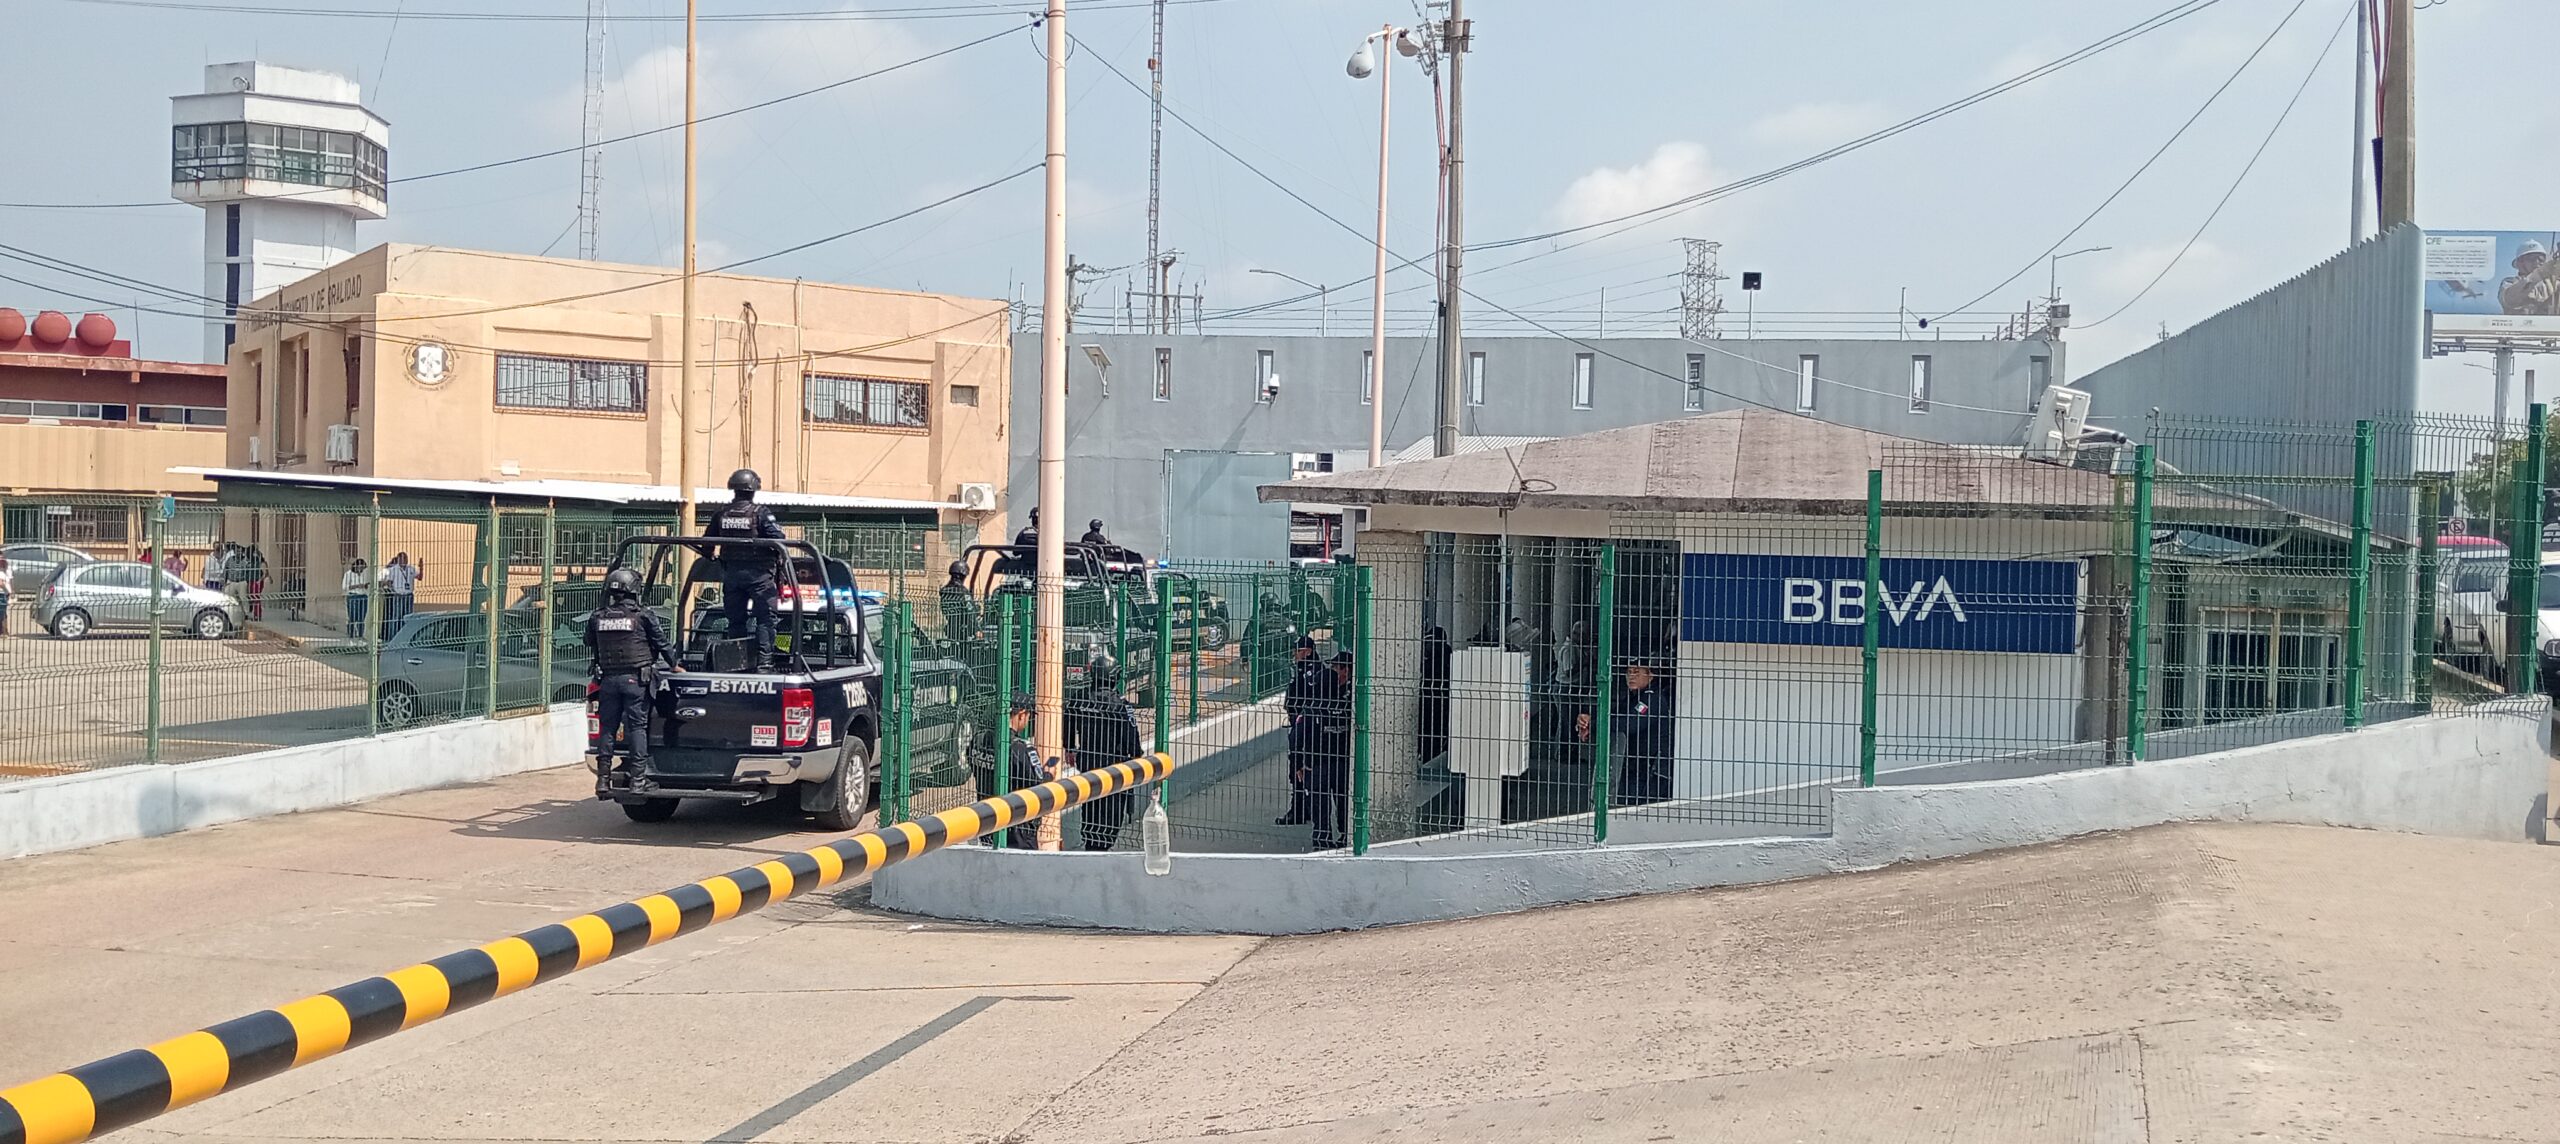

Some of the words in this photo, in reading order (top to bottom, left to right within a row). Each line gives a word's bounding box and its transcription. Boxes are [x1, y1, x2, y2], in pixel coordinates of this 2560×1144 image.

[2426, 237, 2441, 245] CFE
[1783, 574, 1967, 627] BBVA
[710, 680, 777, 694] ESTATAL
